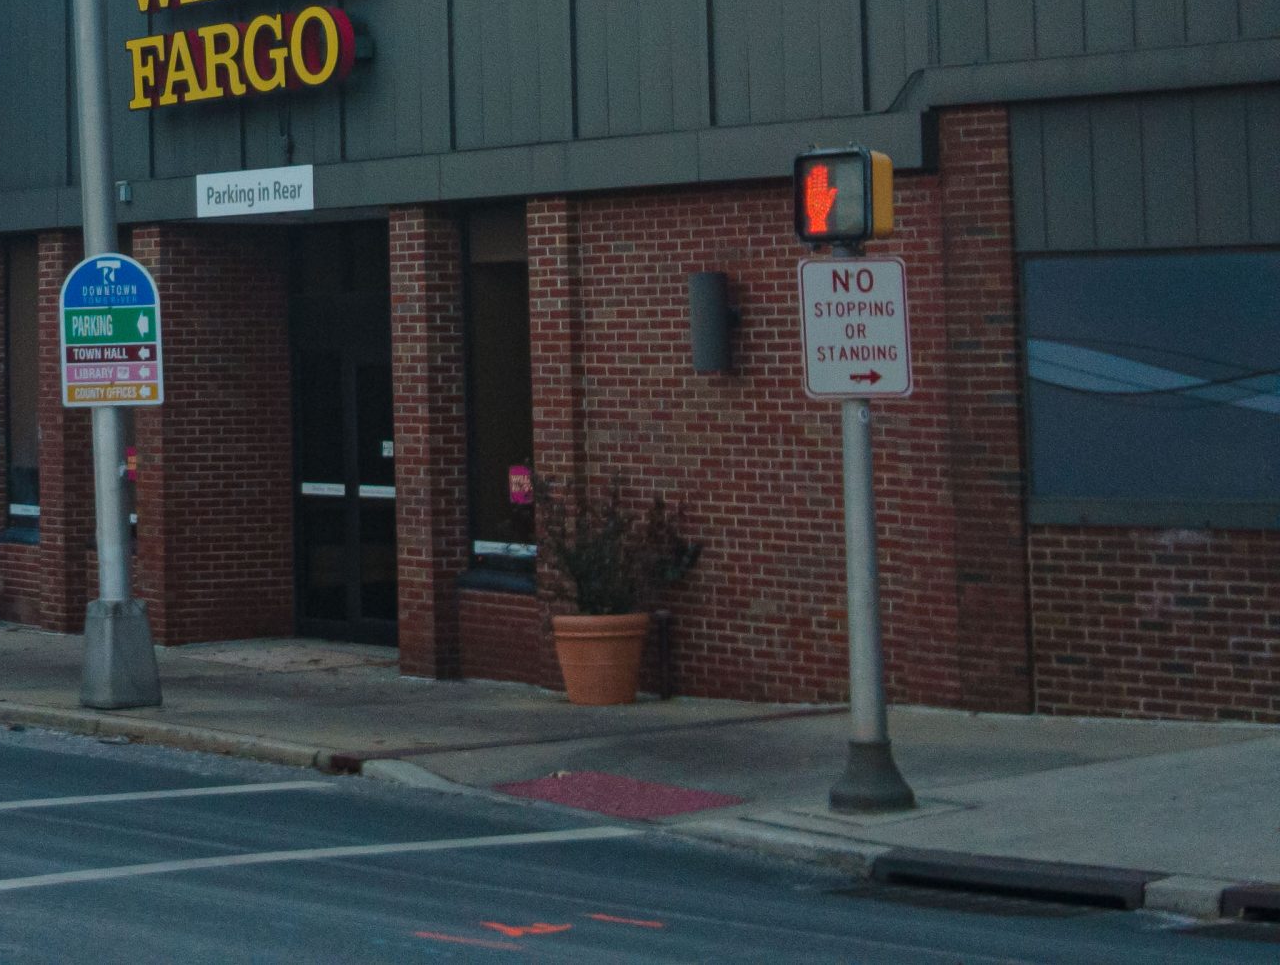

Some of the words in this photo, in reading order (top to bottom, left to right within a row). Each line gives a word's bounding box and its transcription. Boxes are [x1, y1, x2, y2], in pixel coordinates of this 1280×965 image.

[125, 5, 342, 110] FARGO
[206, 184, 256, 208] Parking
[257, 182, 271, 199] in
[272, 181, 303, 201] Rear
[831, 268, 875, 294] NO
[82, 284, 138, 297] DOWNTOWN
[813, 301, 896, 319] STOPPING
[72, 314, 113, 337] PARKING
[844, 323, 867, 339] OR
[72, 348, 103, 360] TOWN
[104, 346, 129, 359] HALL
[816, 345, 898, 363] STANDING
[74, 366, 115, 380] LIBRARY
[74, 387, 105, 400] COUNTY
[106, 386, 138, 399] OFFICES
